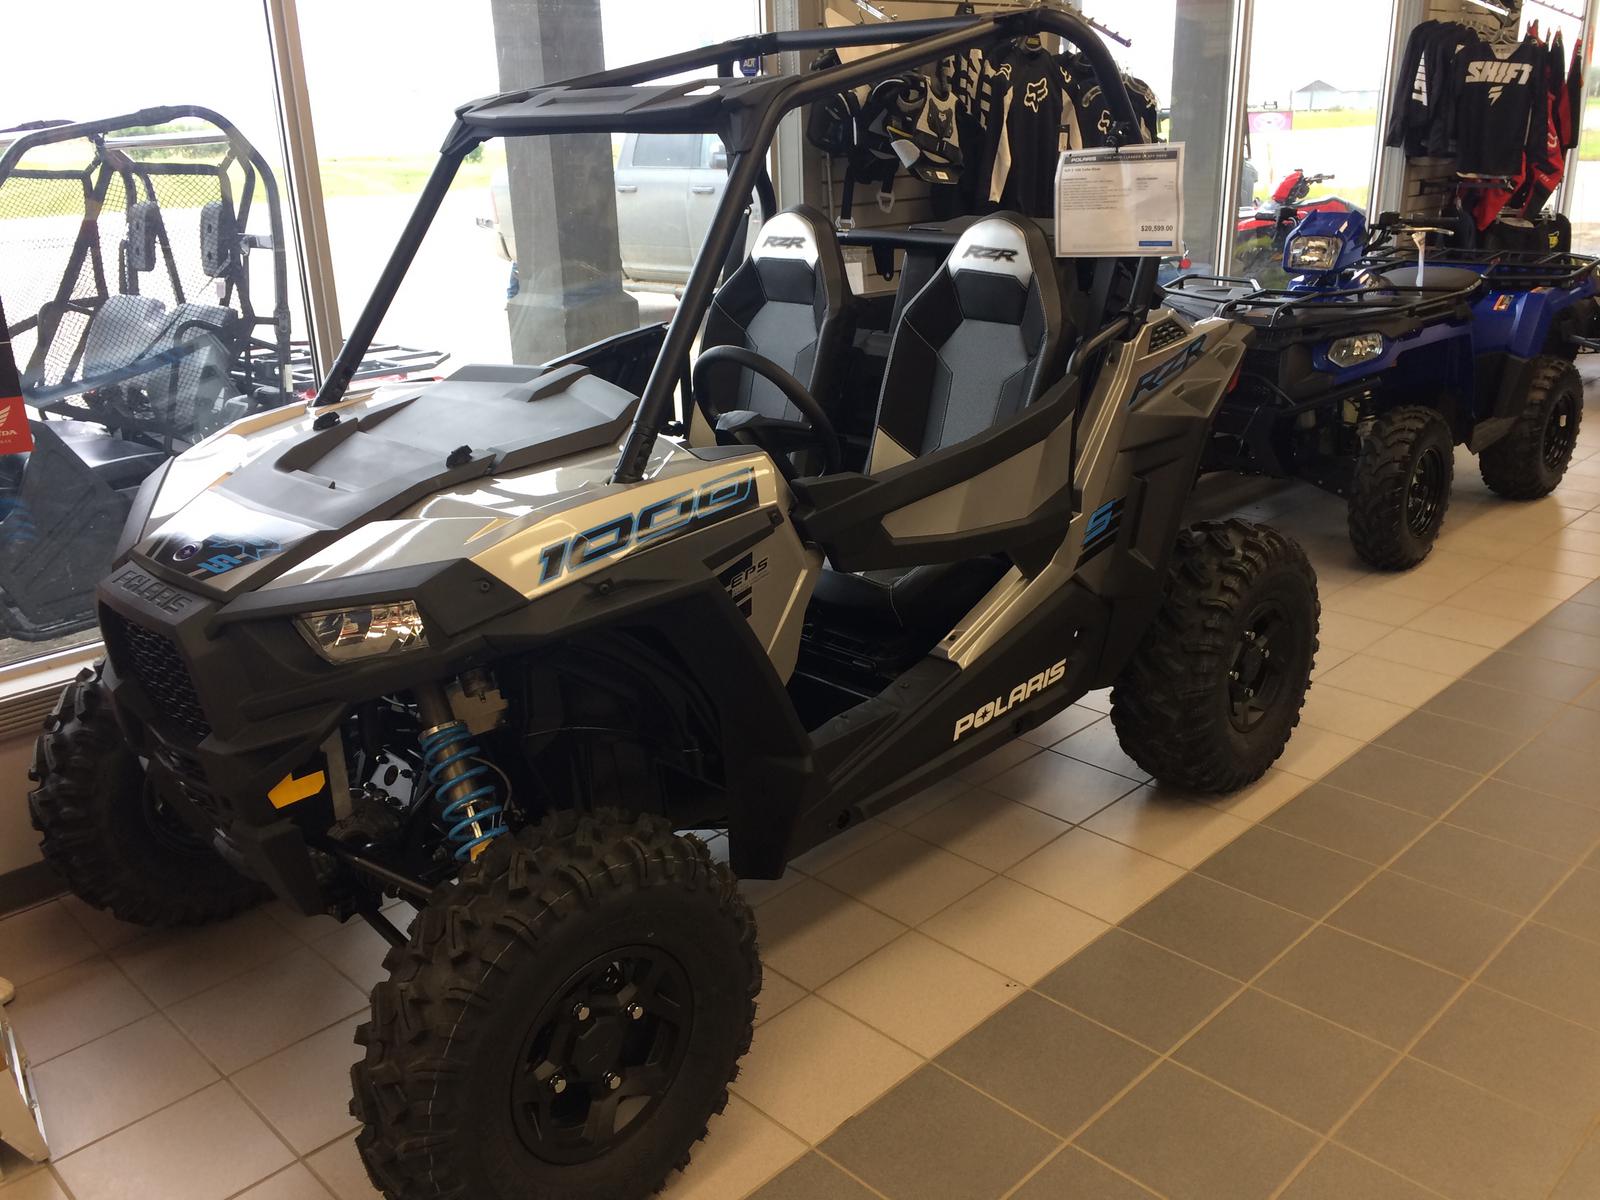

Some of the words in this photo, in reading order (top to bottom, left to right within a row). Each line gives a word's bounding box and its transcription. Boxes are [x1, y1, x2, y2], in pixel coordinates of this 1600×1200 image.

[1465, 61, 1533, 85] SHIFT
[762, 236, 805, 249] RZR
[962, 245, 1019, 263] RZR
[538, 467, 756, 585] 1000
[730, 557, 769, 588] EPS
[953, 658, 1067, 742] POLARIS
